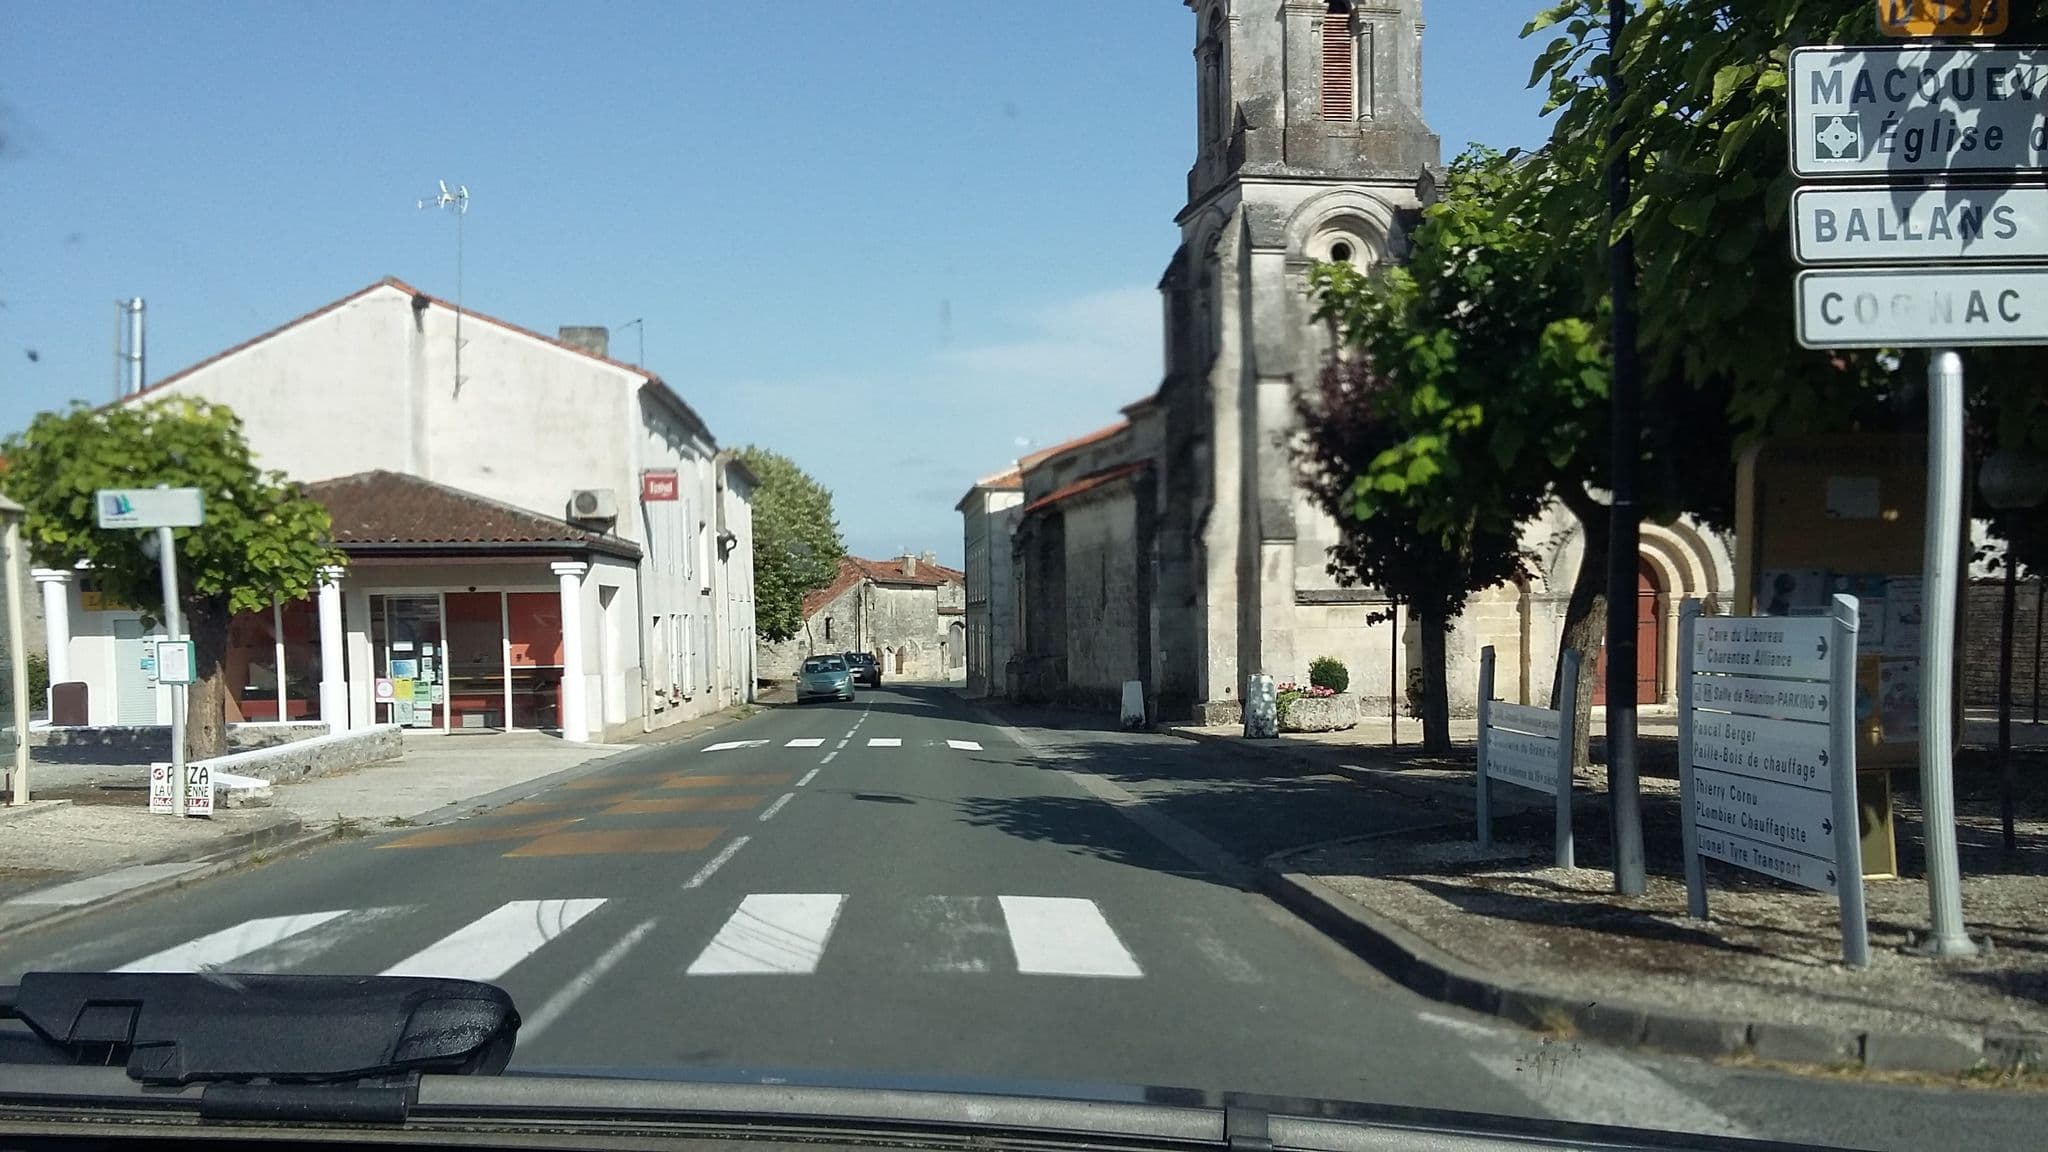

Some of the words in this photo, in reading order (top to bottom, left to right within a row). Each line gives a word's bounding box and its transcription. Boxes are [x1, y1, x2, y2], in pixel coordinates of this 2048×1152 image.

[1877, 111, 2004, 163] Église
[1814, 205, 2018, 243] BALLANS
[1732, 627, 1741, 642] du
[1707, 648, 1751, 665] Charentes
[1754, 649, 1792, 667] Alliance
[1693, 720, 1721, 738] Pascal
[1725, 723, 1756, 746] Berger
[1748, 752, 1759, 769] de
[1763, 755, 1816, 782] chauffage
[1695, 778, 1725, 801] Thierry
[1730, 785, 1758, 806] Cornu
[1741, 812, 1807, 843] Chauffagiste
[1698, 834, 1725, 855] Lionel
[1729, 842, 1748, 862] Tyre
[1753, 848, 1801, 876] Transport
